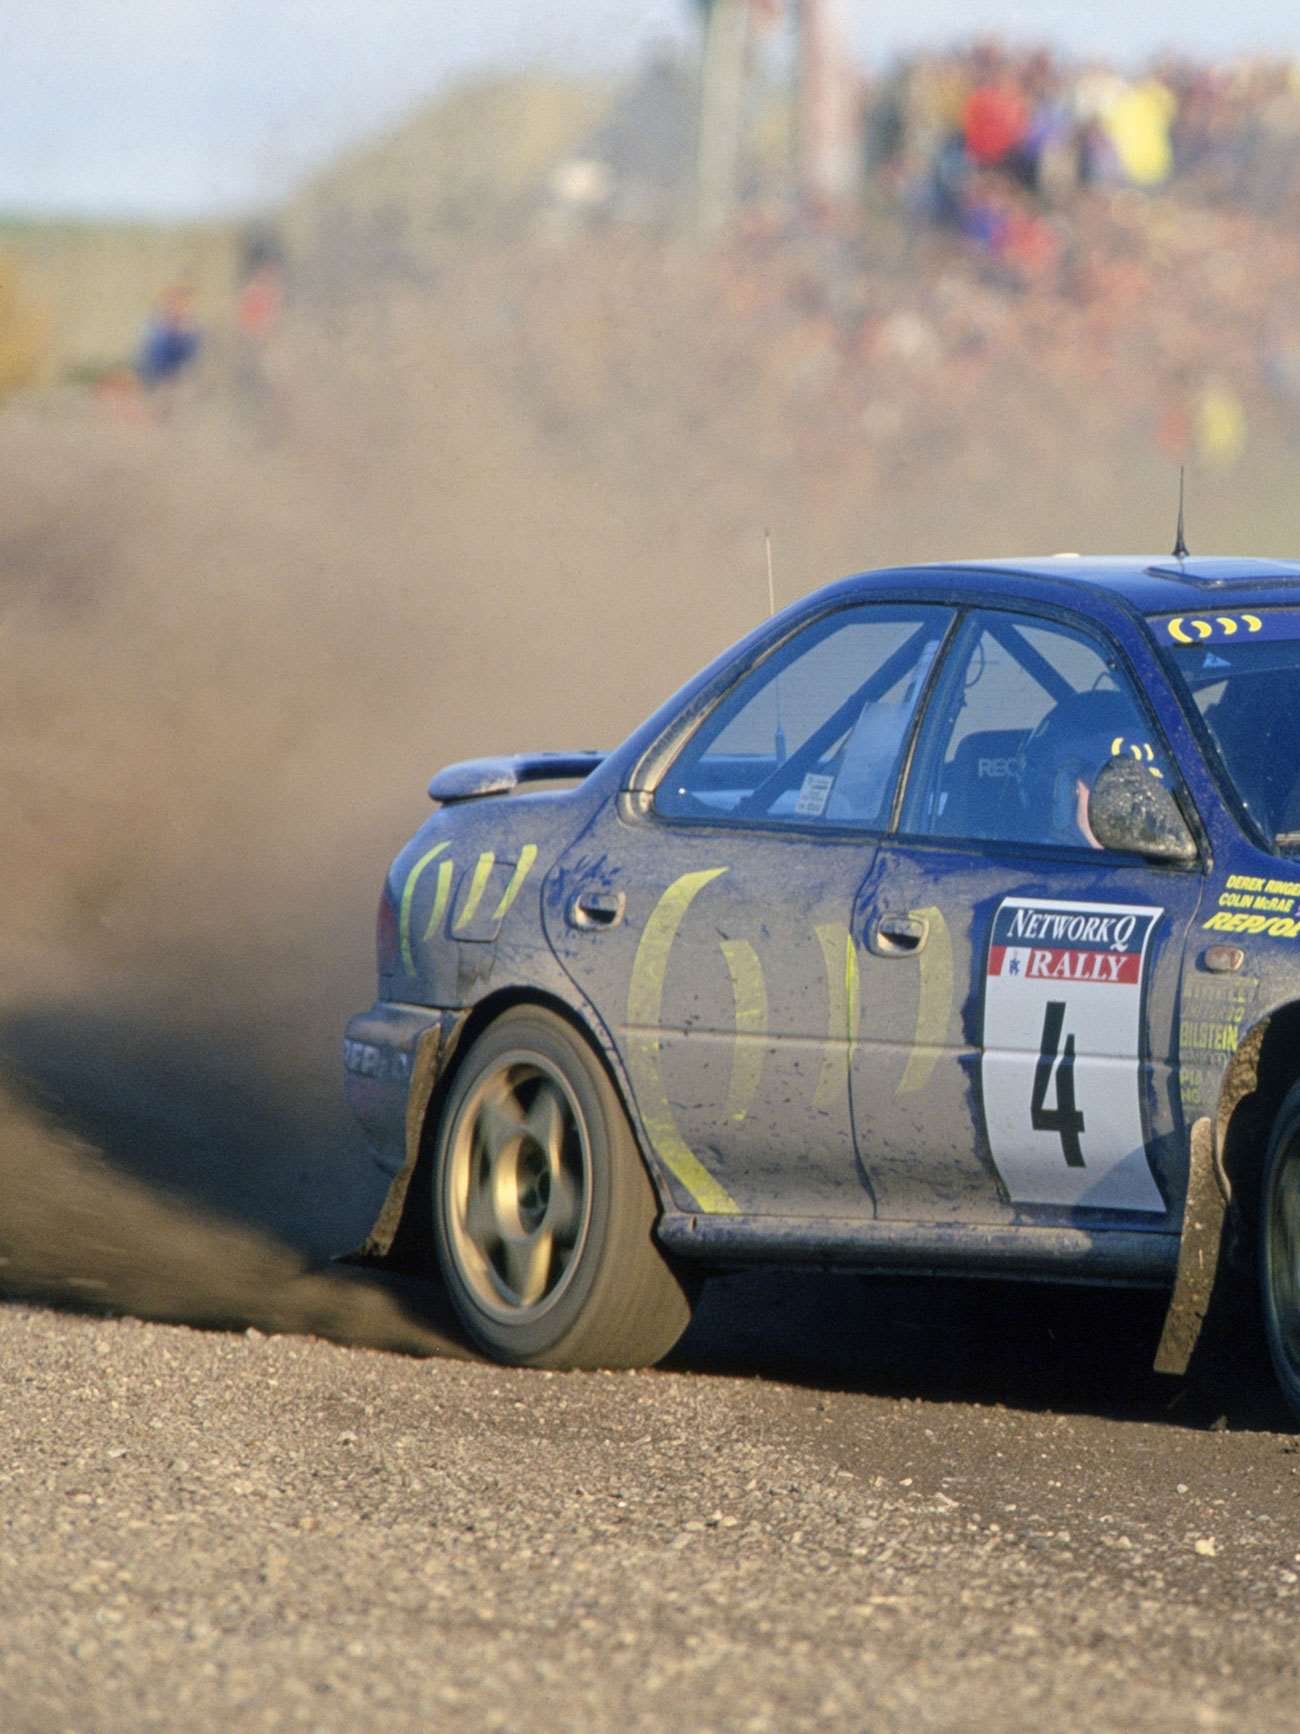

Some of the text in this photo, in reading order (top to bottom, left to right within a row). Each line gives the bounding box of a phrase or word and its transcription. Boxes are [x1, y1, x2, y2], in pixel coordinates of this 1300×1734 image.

[1226, 874, 1265, 892] DEREK
[1218, 892, 1254, 908] COLIN
[1007, 908, 1115, 943] NETWORK
[1030, 950, 1128, 981] RALLY
[1179, 1021, 1238, 1053] BILSTEIN
[1031, 1001, 1087, 1168] 4
